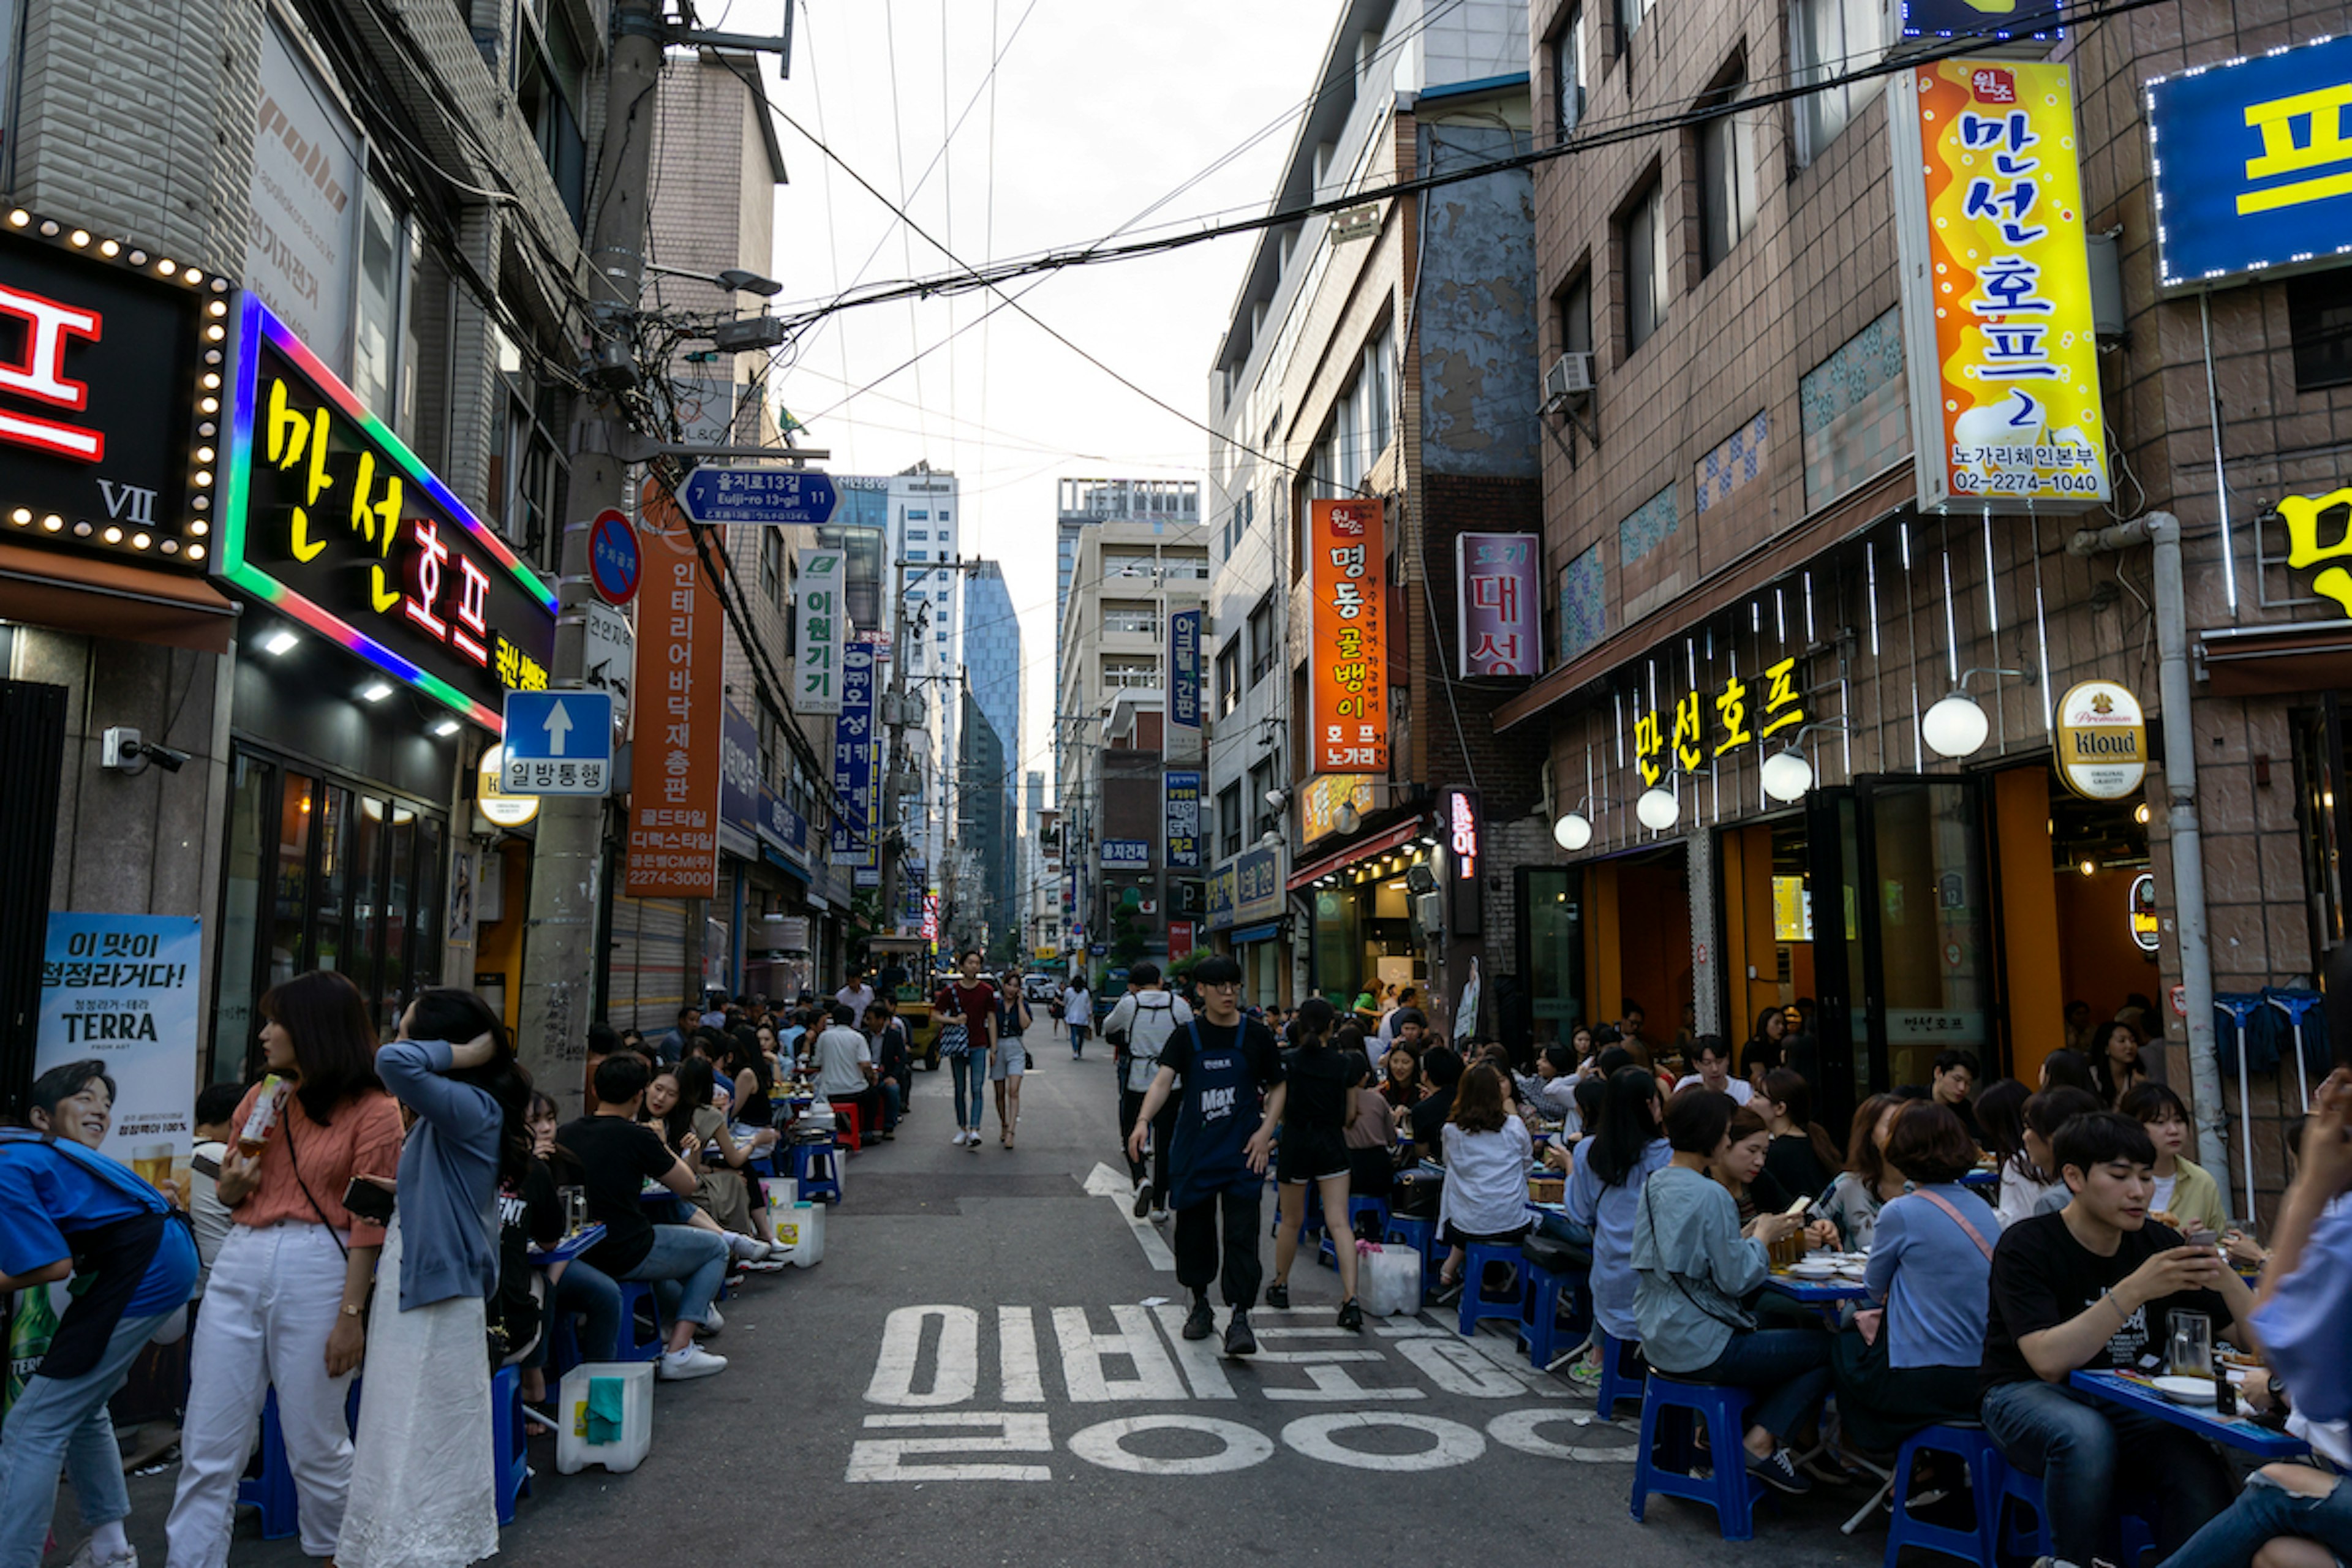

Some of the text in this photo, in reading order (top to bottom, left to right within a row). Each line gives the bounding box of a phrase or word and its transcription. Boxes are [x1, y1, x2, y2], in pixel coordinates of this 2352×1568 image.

[1973, 70, 2015, 102] 원조
[1962, 113, 2057, 427] 만선호프 2
[1954, 445, 2095, 467] 노가리체인본부
[695, 488, 705, 500] 7
[717, 472, 801, 493] 을지로13길
[1954, 472, 2098, 491] 02-2274-1040
[717, 493, 801, 508] Eulji-ro 13-gil
[810, 491, 825, 503] 11
[266, 377, 491, 667] 만선호프
[595, 541, 635, 571] 주차금지
[1474, 543, 1527, 565] 도기
[589, 612, 632, 652] 견인지역
[805, 591, 832, 698] 이원기기
[1330, 544, 1366, 719] 명동골뱅이
[1634, 657, 1805, 787] 만선호프
[2074, 710, 2132, 726] Premium
[2075, 730, 2136, 755] Kloud
[1327, 748, 1375, 766] 노가리
[511, 762, 601, 788] 일방통행
[629, 870, 712, 886] 2274-3000
[69, 932, 160, 959] 이 맛이
[61, 1012, 159, 1044] TERRA
[1200, 1085, 1237, 1112] Max
